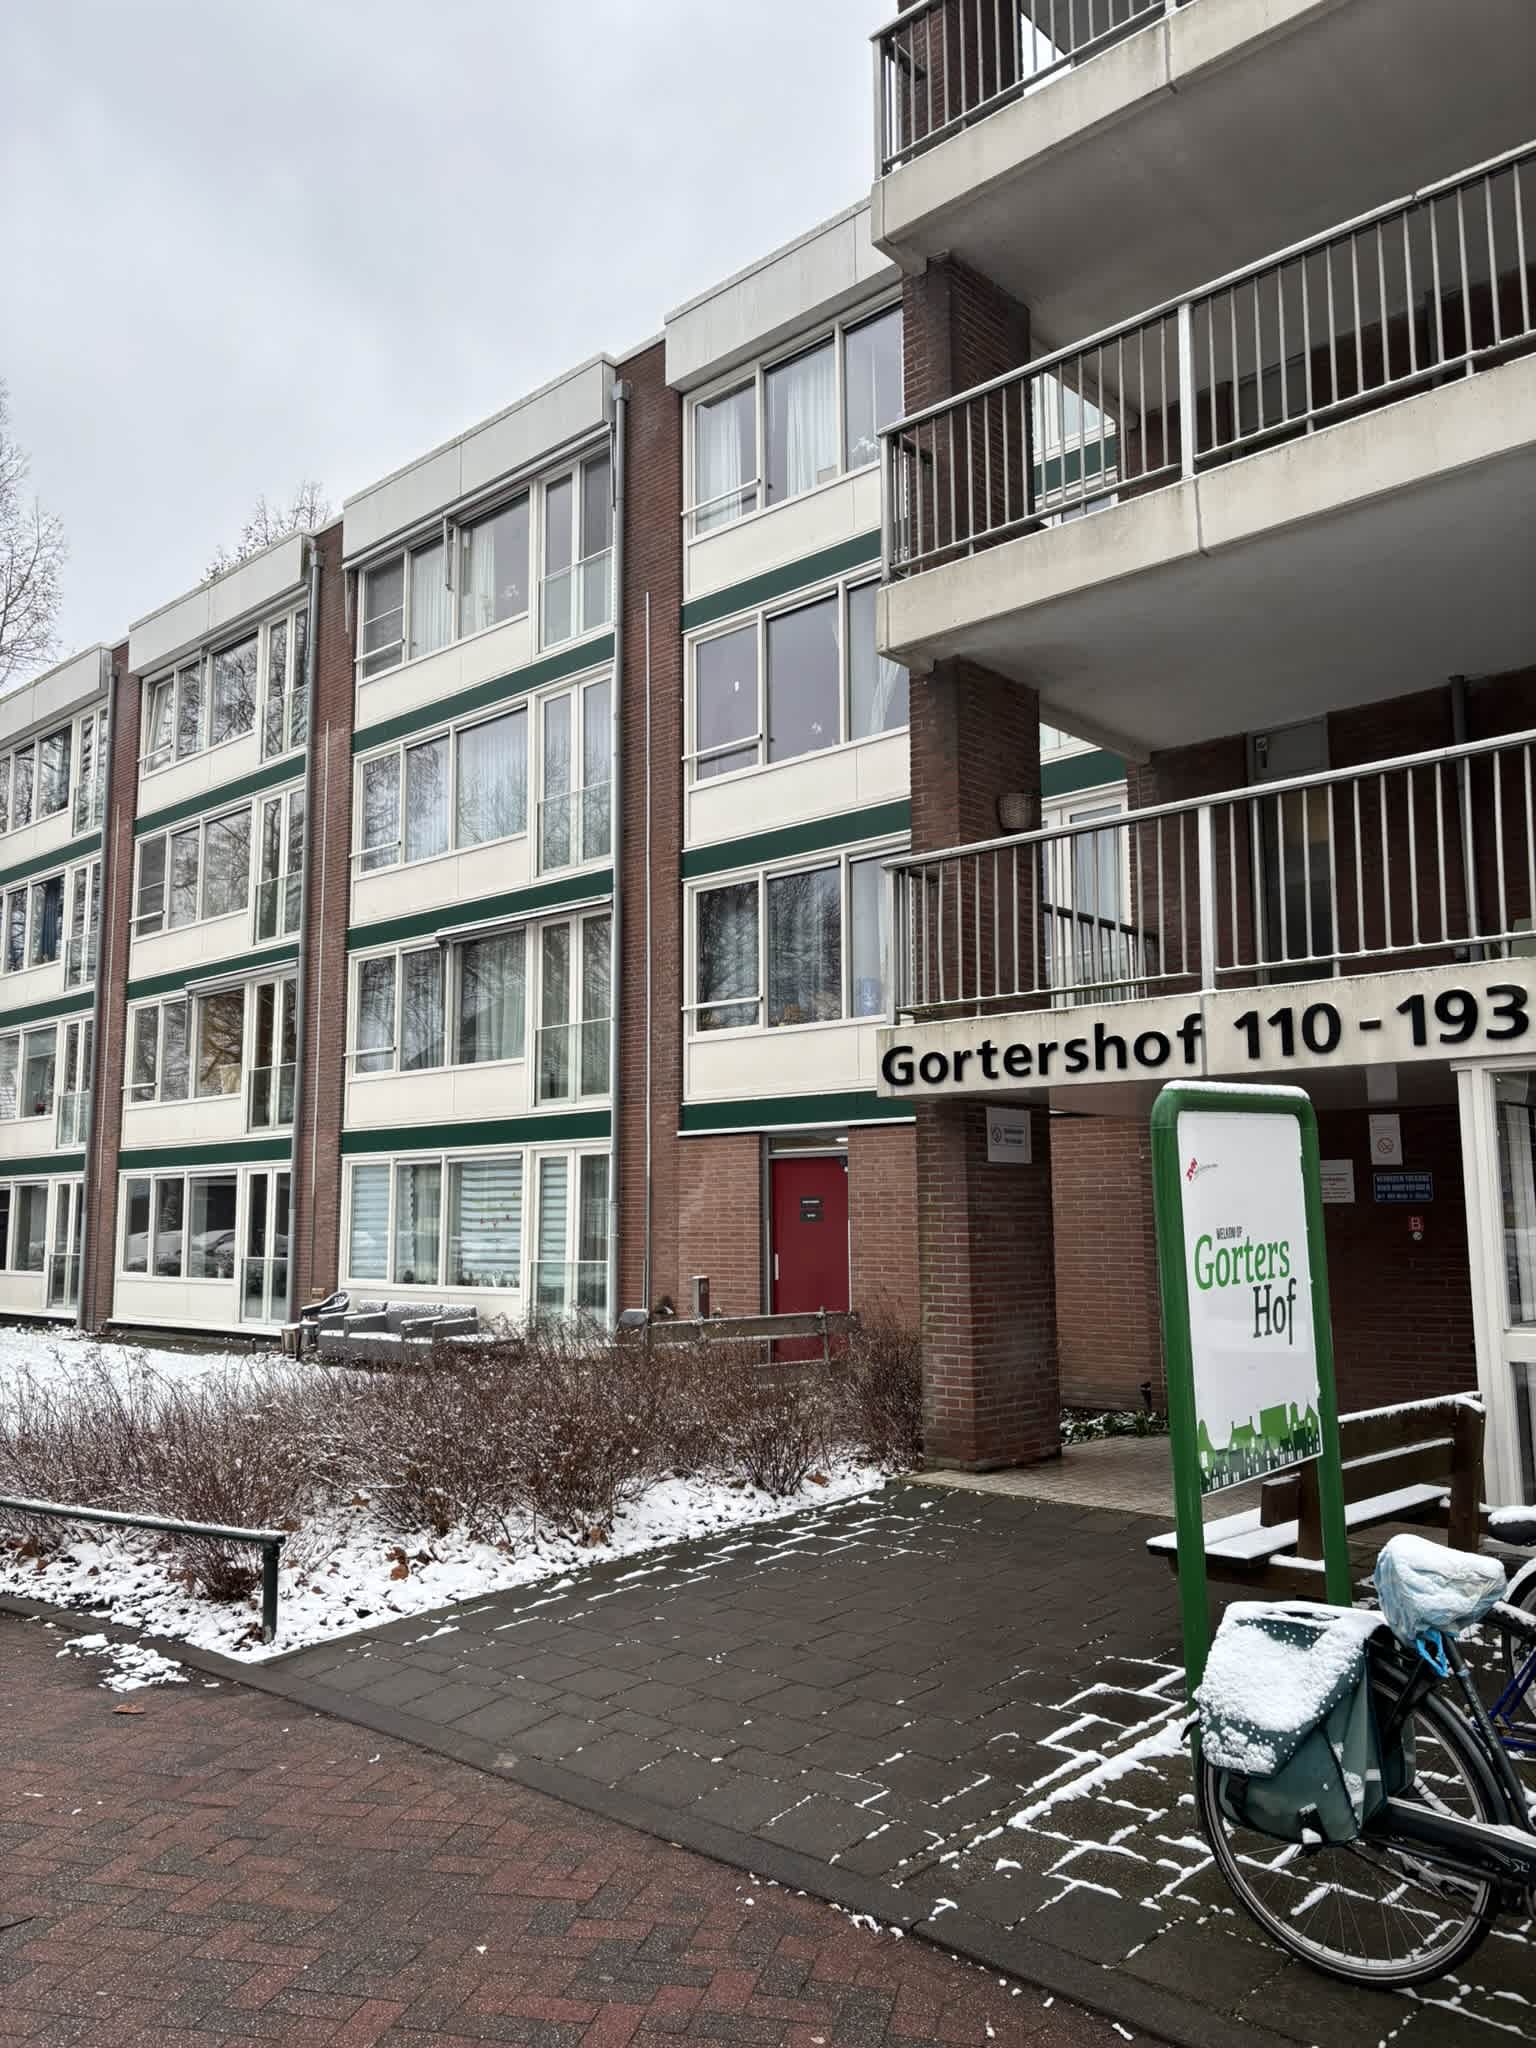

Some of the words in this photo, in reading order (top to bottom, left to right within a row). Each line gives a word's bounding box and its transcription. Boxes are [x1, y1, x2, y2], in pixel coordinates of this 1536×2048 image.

[881, 1013, 1204, 1088] Gortershof
[1233, 1002, 1343, 1060] 110
[1396, 985, 1530, 1047] 193
[1195, 1235, 1290, 1290] Gorters
[1253, 1278, 1297, 1345] Hof
